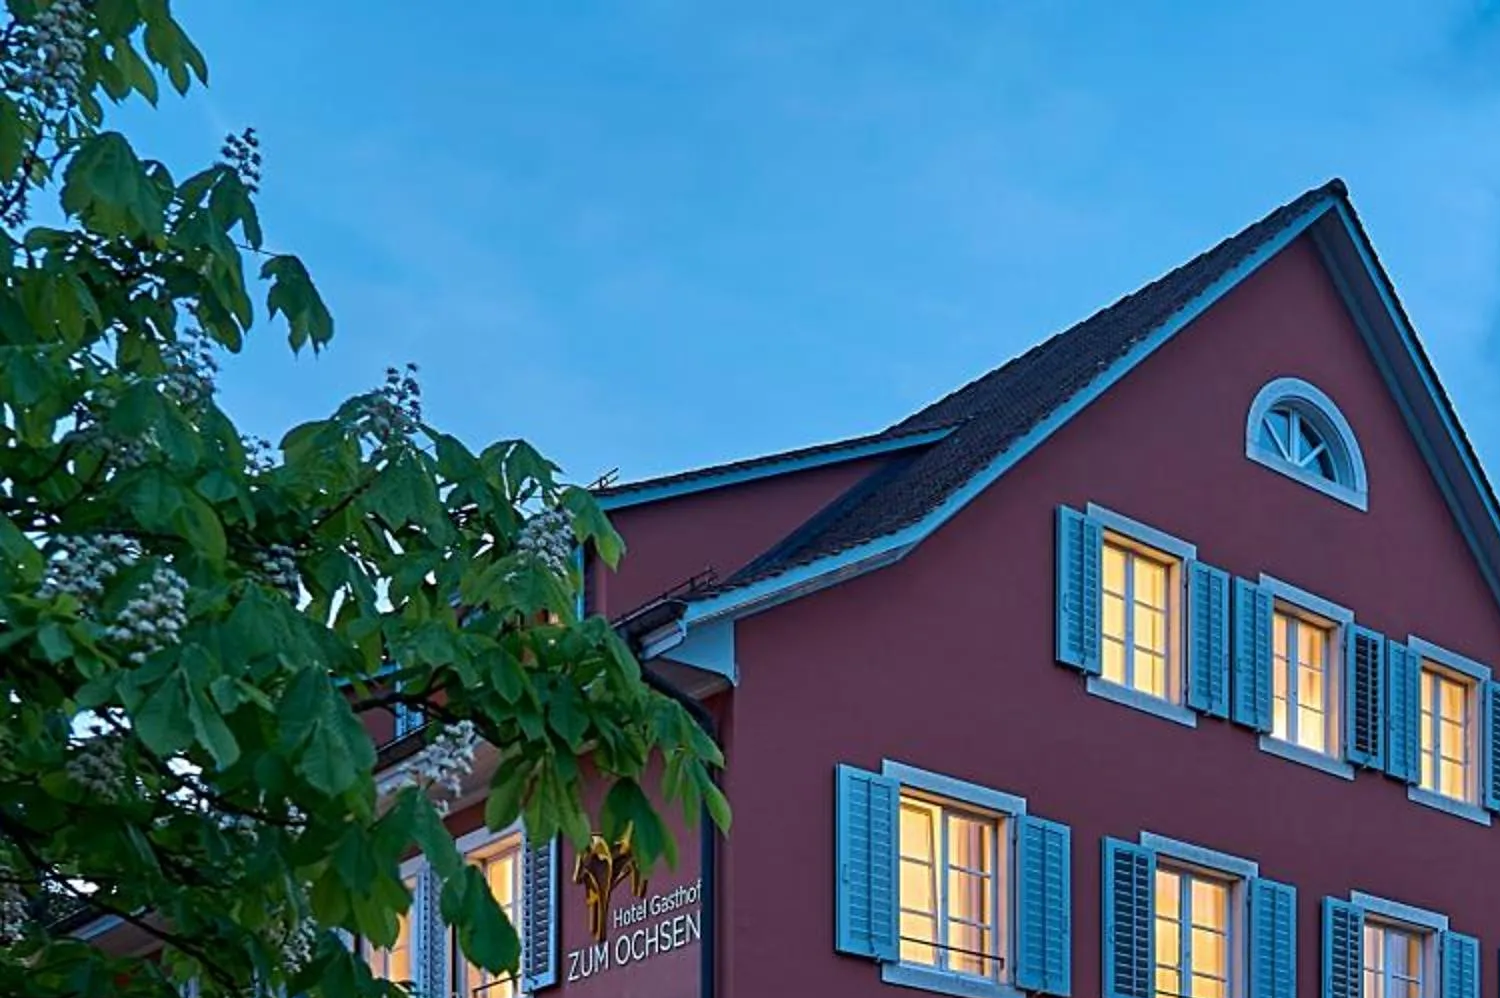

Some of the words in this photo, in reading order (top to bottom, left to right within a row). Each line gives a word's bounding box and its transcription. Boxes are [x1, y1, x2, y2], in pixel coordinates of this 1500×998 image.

[613, 898, 647, 929] Hotel
[650, 879, 702, 916] Gasthof
[567, 941, 609, 982] ZUM
[615, 909, 702, 966] OCHSEN
